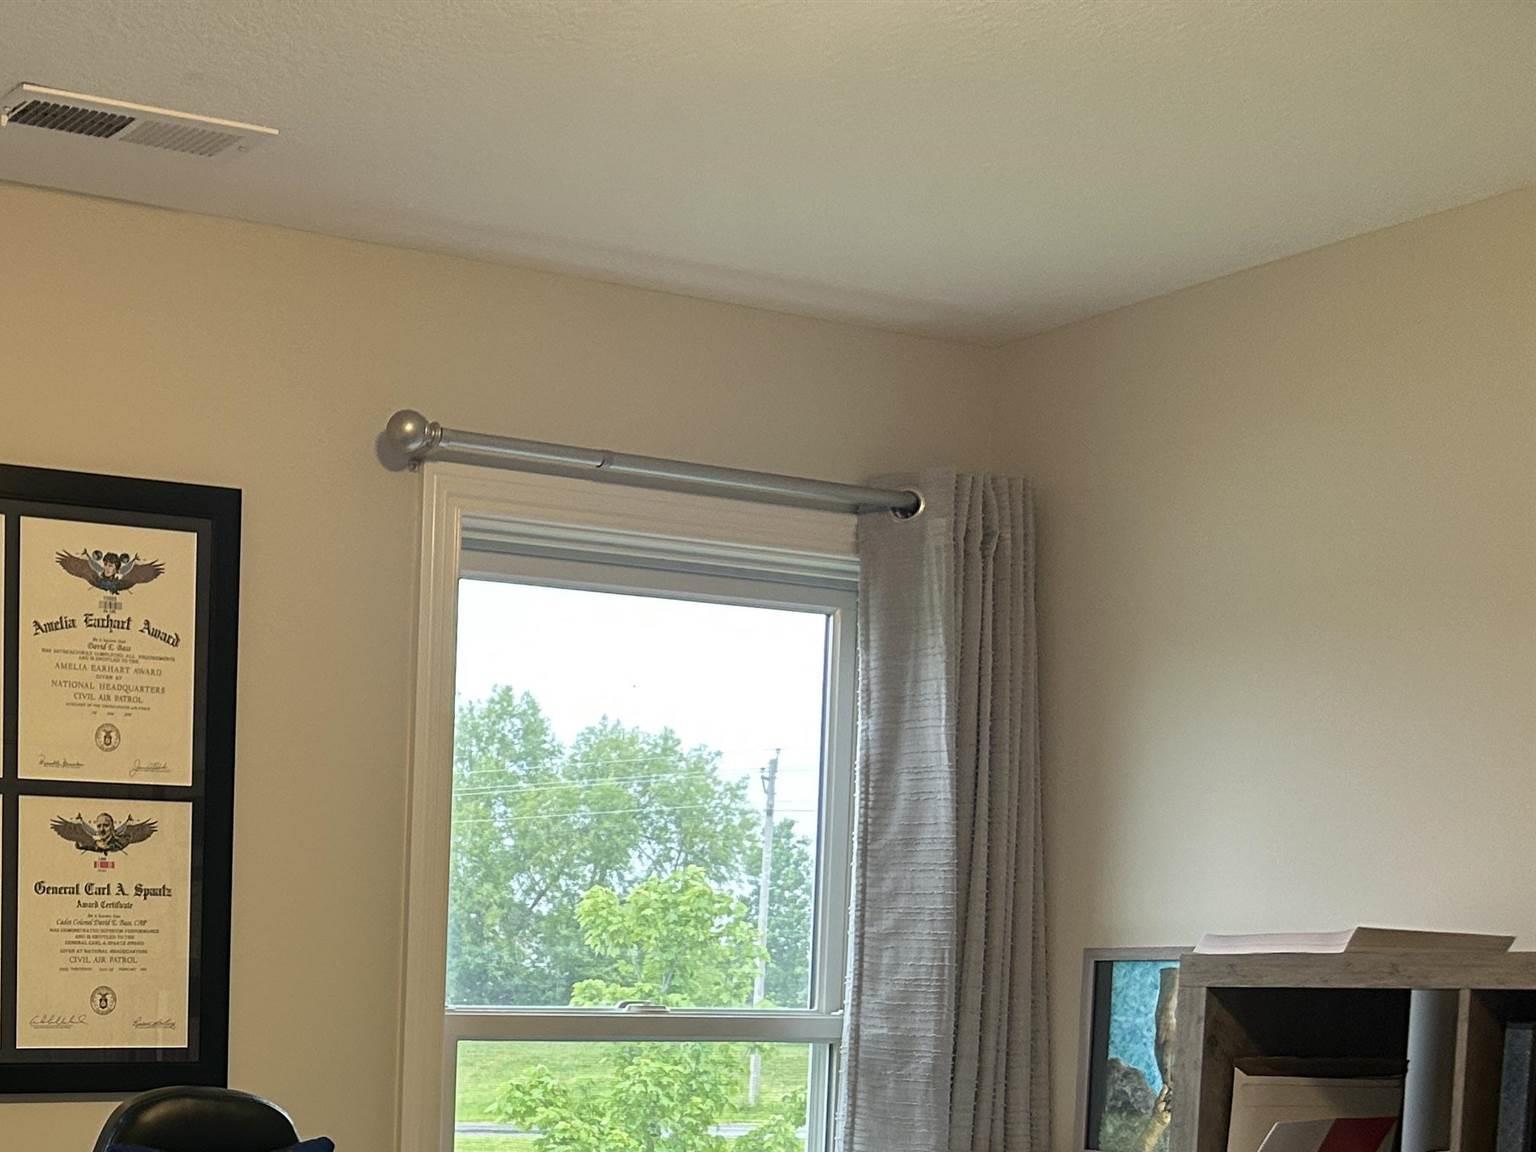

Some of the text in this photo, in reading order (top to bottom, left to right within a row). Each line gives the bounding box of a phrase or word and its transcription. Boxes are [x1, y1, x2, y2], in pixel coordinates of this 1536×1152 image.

[32, 613, 182, 648] Amelia Earhart Award
[55, 662, 162, 677] AMELIA EARHART AWARD
[51, 679, 166, 695] NATIONAL HEADQUARTERS
[73, 692, 143, 704] CIVIL AIR PATROL
[33, 881, 172, 900] General Carl A. Spaatz
[76, 900, 133, 909] Award Certificate
[69, 956, 138, 964] CIVIL AIR PATROL
